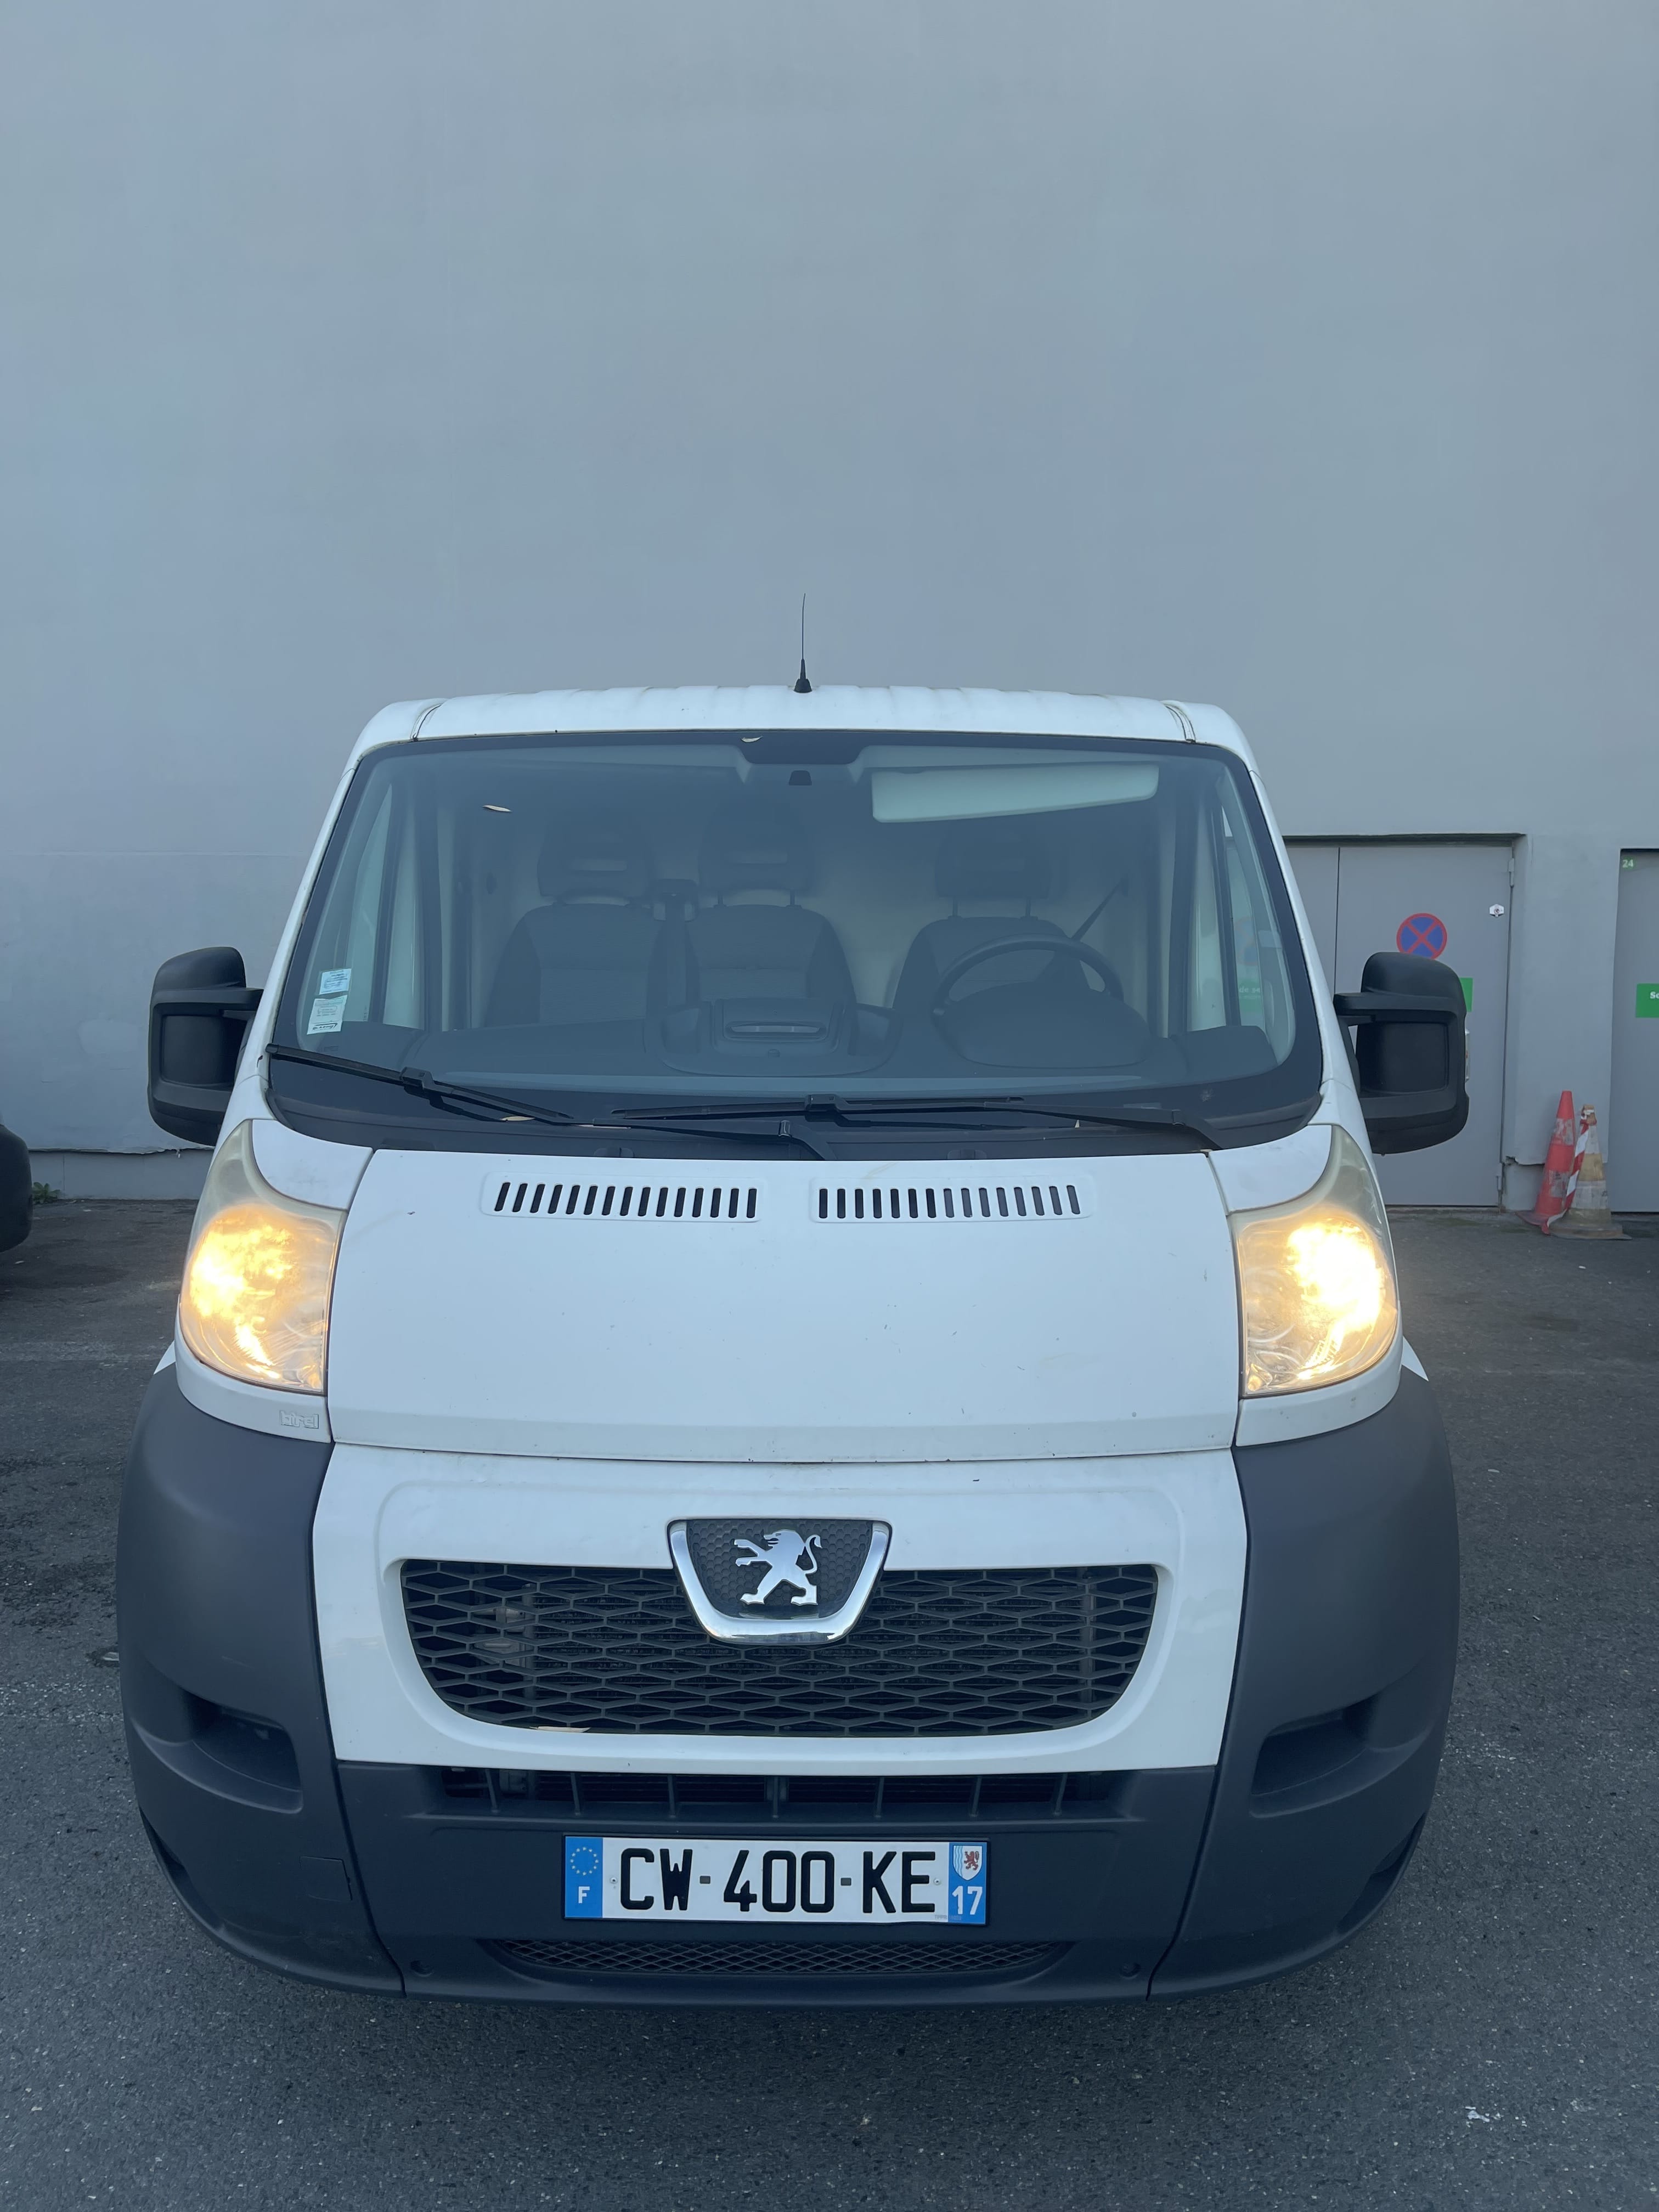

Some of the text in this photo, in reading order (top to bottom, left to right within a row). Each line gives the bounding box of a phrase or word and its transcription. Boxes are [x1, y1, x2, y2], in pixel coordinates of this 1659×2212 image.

[1622, 859, 1633, 868] 24
[620, 1848, 935, 1913] CW-400-KE
[578, 1886, 590, 1904] F
[952, 1886, 983, 1915] 17
